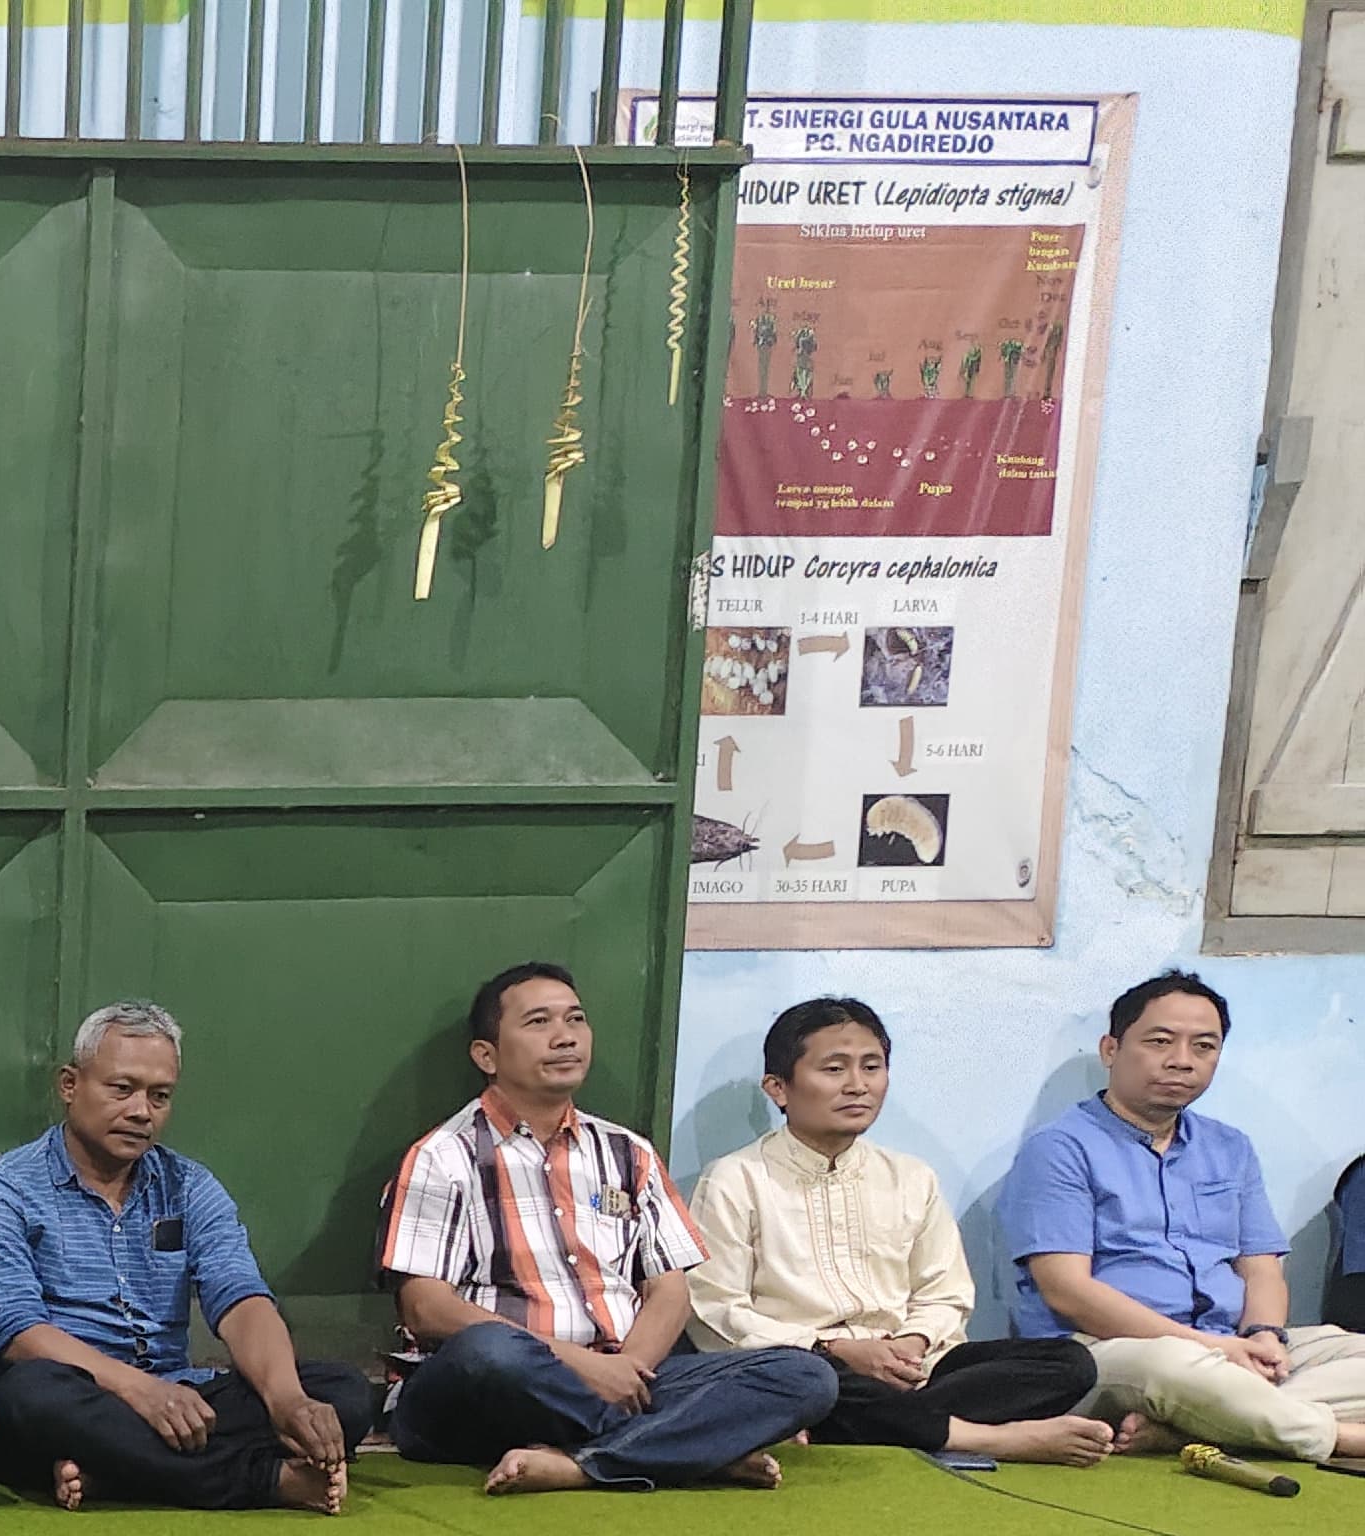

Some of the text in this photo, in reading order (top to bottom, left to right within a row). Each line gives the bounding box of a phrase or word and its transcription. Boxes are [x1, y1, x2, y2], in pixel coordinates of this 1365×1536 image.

[747, 110, 1070, 131] T. SINERGI GULA NUSANTARA
[850, 133, 994, 154] NGADIREDJO
[739, 180, 1075, 213] HIDUP URET (Lepidiopta stigma)
[800, 224, 926, 241] Siklus hidup uret
[733, 554, 795, 578] HIDUP
[804, 554, 881, 585] Corcyra
[886, 554, 998, 585] cephalonica
[717, 599, 764, 613] TELUR
[893, 599, 938, 613] LARVA
[822, 611, 859, 625] HARI
[948, 743, 984, 757] HARI
[692, 880, 744, 895] IMAGO
[775, 879, 848, 893] 30-35 HARI
[881, 879, 917, 894] PUPA
